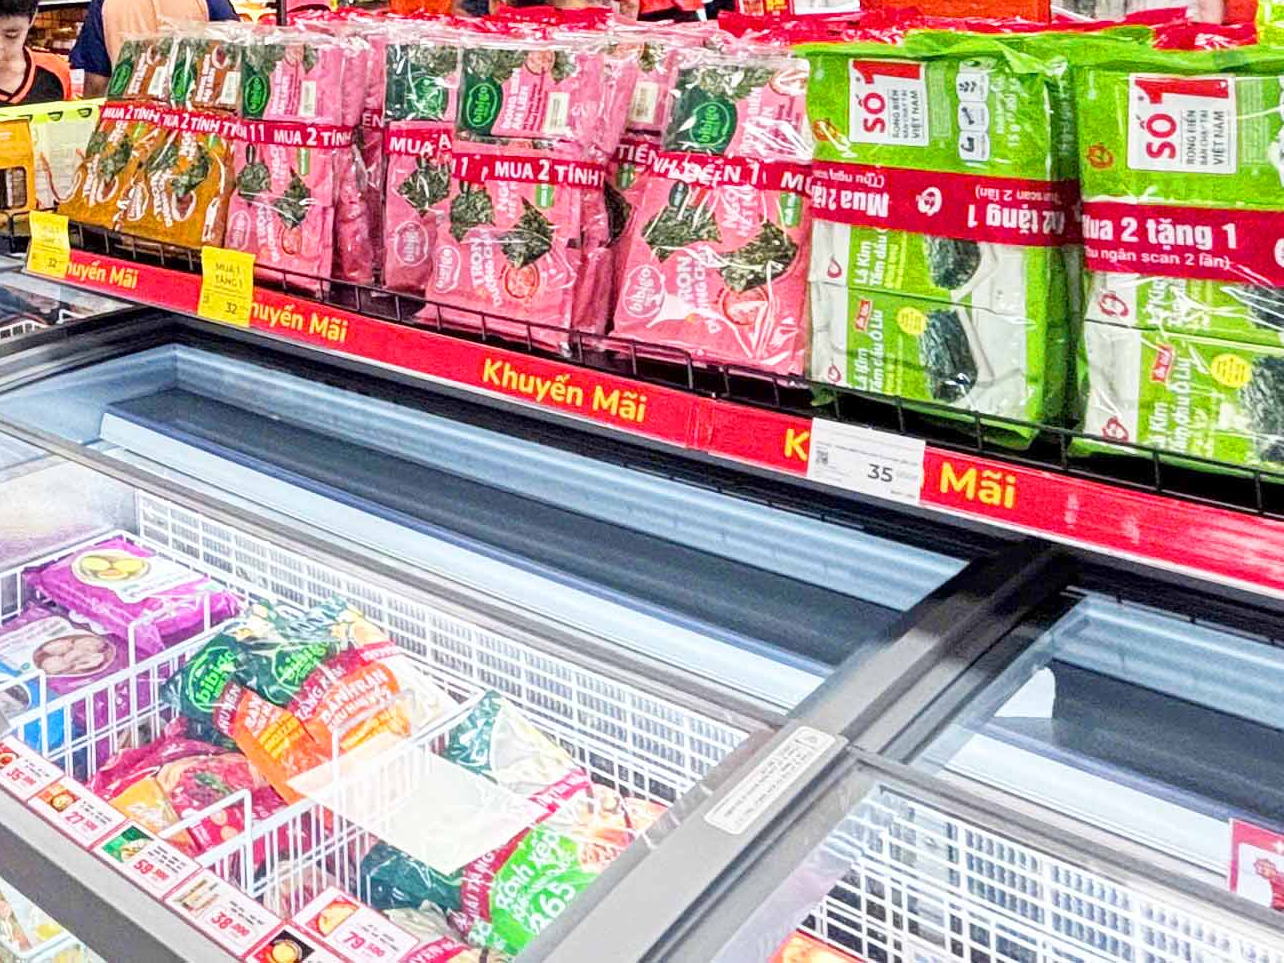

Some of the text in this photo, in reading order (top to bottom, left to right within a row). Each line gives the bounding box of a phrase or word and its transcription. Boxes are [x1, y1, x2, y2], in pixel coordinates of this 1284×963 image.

[853, 60, 921, 133] SỐ 1
[103, 106, 160, 123] MUA 2 TÍNH
[180, 114, 189, 129] 2
[190, 117, 220, 132] TÍNH
[1135, 79, 1229, 159] SỐ 1
[274, 128, 352, 147] MUA 2 TÍNH
[1212, 110, 1225, 165] VIỆT NAM
[495, 159, 598, 186] MUA 2 TÍNH
[841, 191, 889, 218] Mua
[1002, 187, 1013, 199] 2
[967, 204, 976, 228] 1
[987, 205, 1039, 234] tặng
[1120, 216, 1139, 243] 2
[1146, 217, 1213, 251] tặng
[1221, 222, 1237, 250] 1
[1101, 248, 1136, 263] ngân
[1141, 252, 1181, 265] scan
[1184, 253, 1196, 266] 2
[109, 267, 139, 290] Mãi
[225, 301, 238, 315] 32
[309, 312, 349, 343] Mãi
[482, 358, 648, 423] Khuyến Mãi
[867, 463, 893, 484] 35
[939, 461, 1017, 510] Mãi
[211, 911, 233, 929] 38
[342, 931, 366, 949] 79
